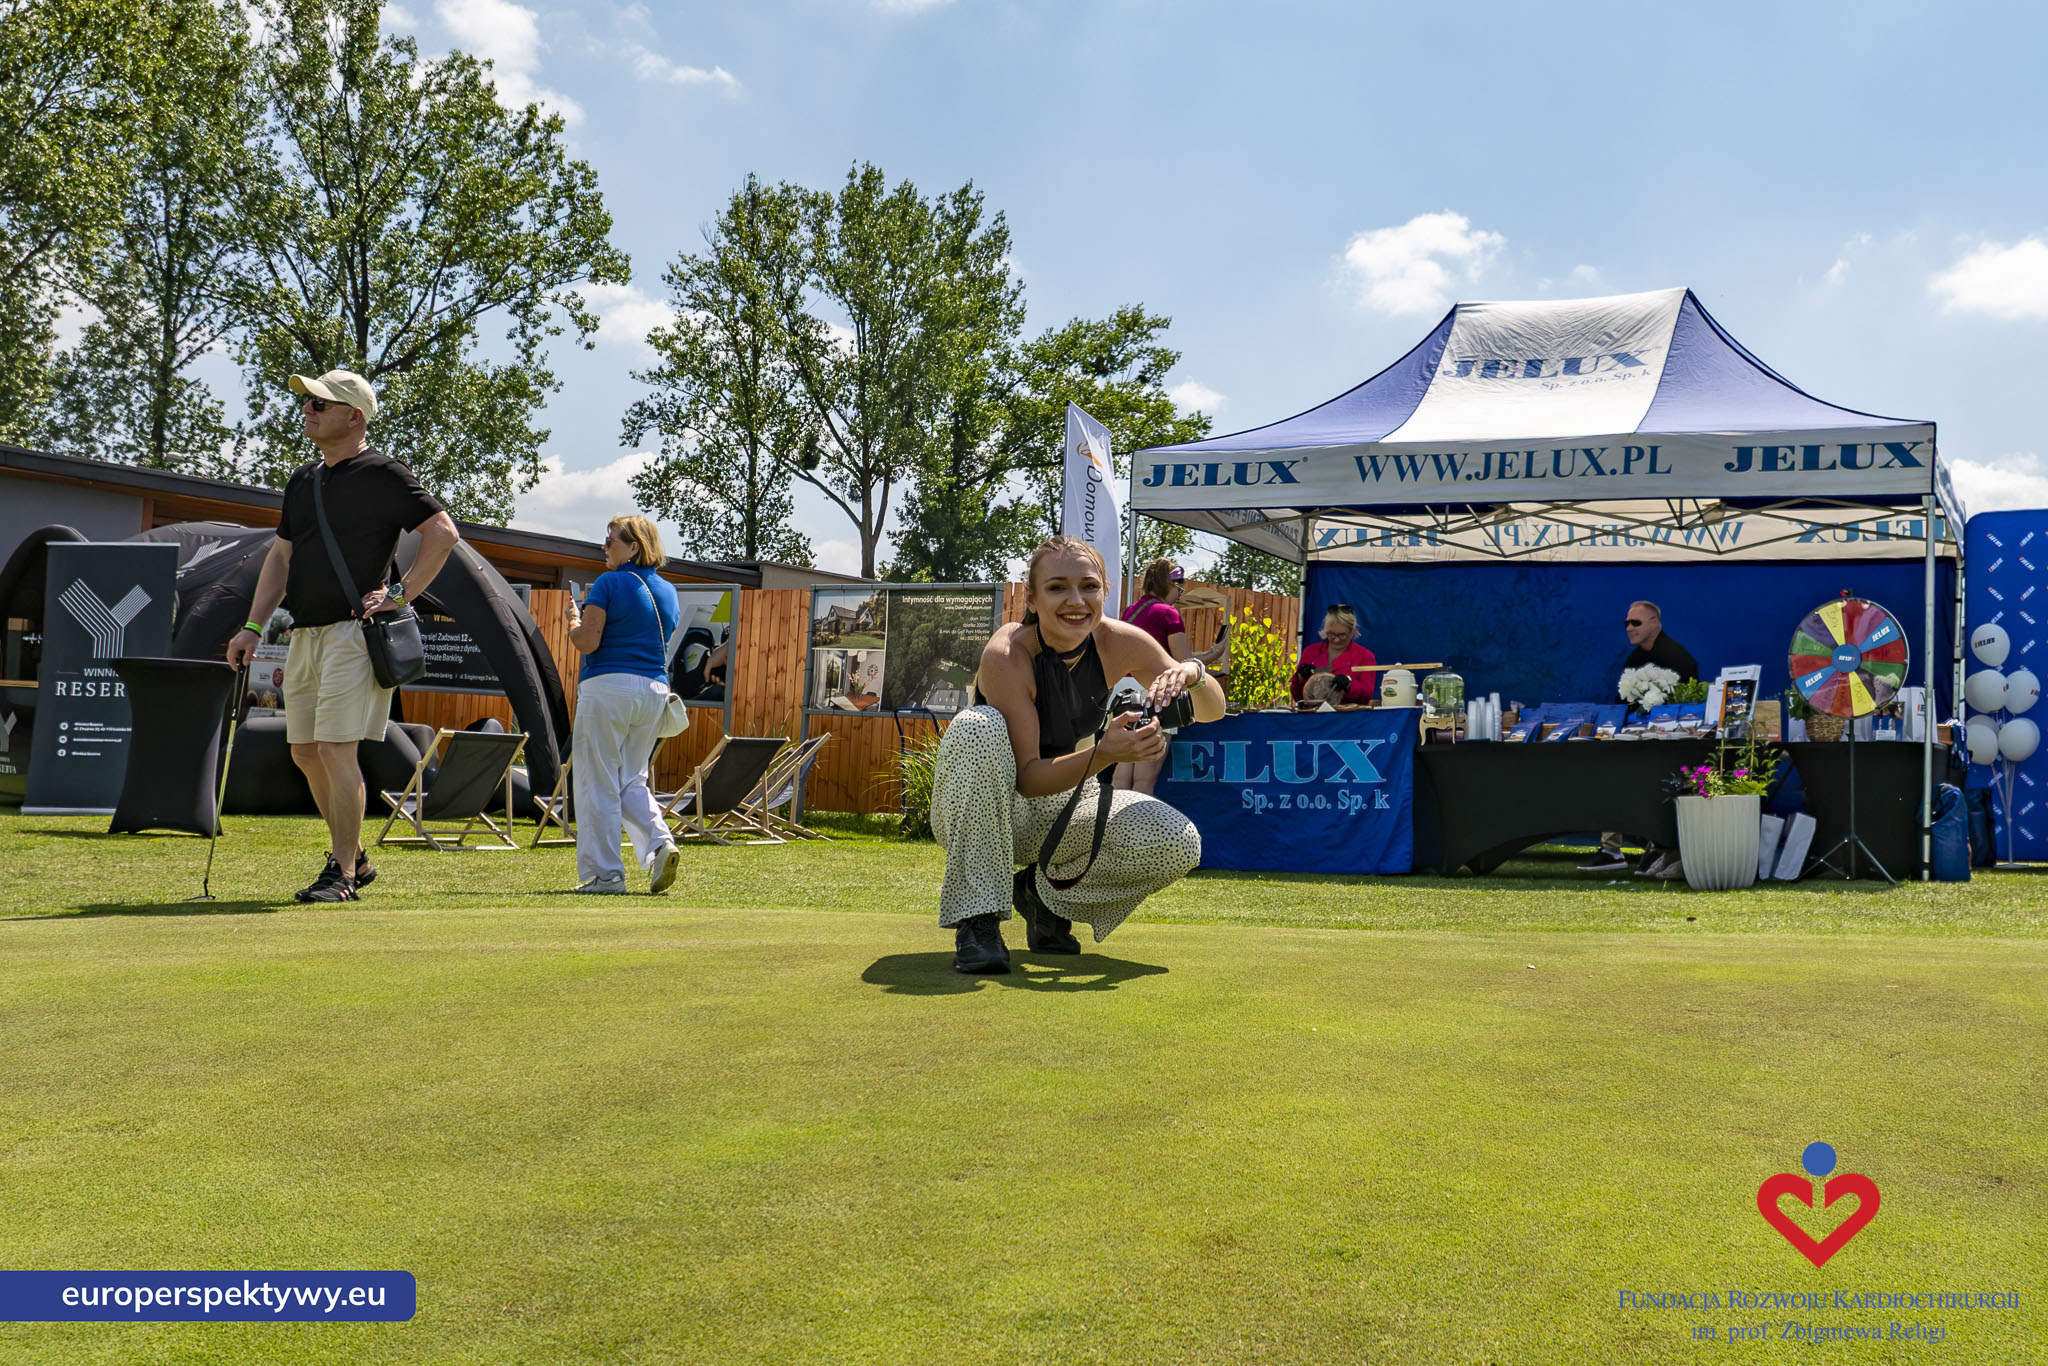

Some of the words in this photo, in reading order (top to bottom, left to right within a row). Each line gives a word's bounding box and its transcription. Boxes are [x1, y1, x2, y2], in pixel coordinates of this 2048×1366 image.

[1442, 350, 1652, 379] JELUX
[1353, 444, 1673, 483] WWW.JELUX.PL
[1723, 441, 1926, 473] JELUX
[1142, 460, 1301, 488] JELUX
[902, 595, 933, 604] Intymność
[934, 595, 945, 603] dla
[945, 594, 993, 605] wymagających
[83, 667, 120, 678] WINNI
[55, 681, 126, 697] RESER
[1167, 739, 1387, 784] ELUX
[1241, 788, 1274, 815] Sp.
[1279, 794, 1292, 809] z
[1296, 794, 1332, 810] o.o.
[1337, 788, 1368, 816] Sp.
[1373, 789, 1391, 809] k
